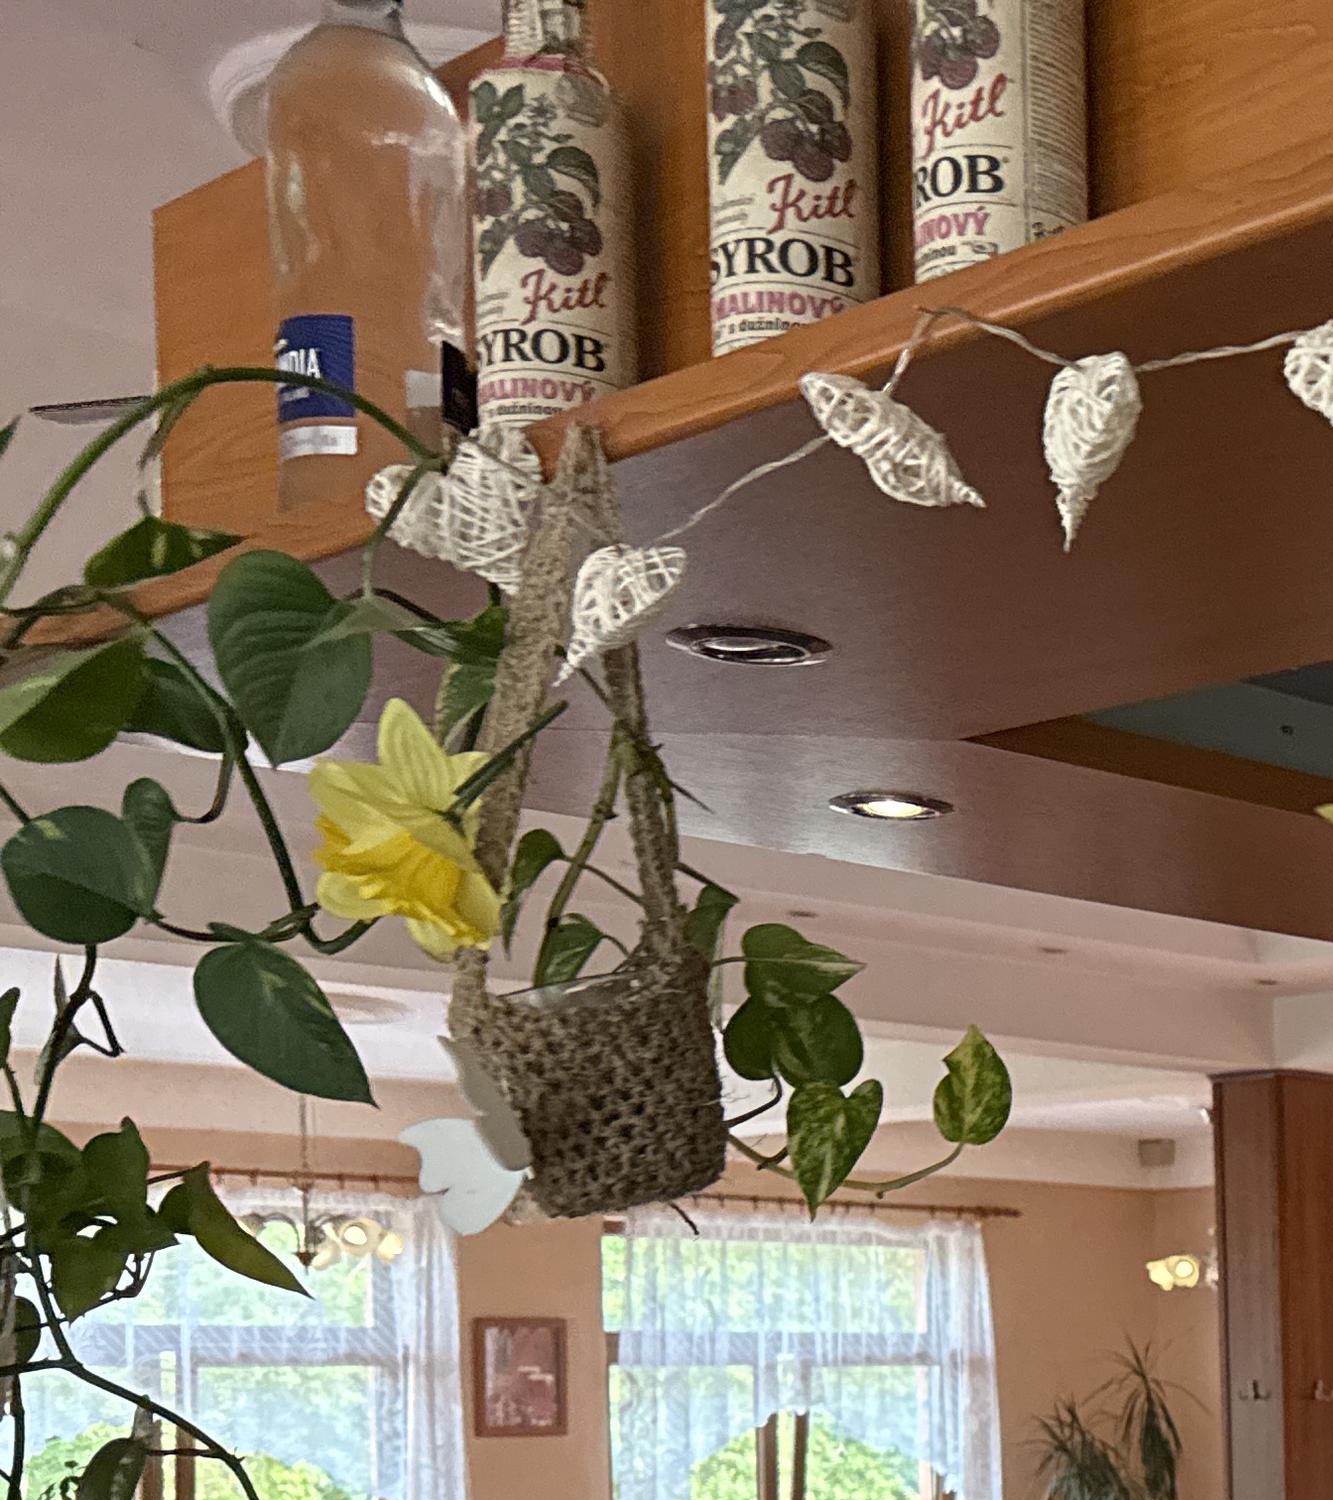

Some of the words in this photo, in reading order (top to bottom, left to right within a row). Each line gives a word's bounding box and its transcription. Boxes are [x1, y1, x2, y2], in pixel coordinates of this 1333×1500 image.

[922, 73, 1009, 162] Kitl
[766, 173, 858, 235] Kitl
[914, 154, 1005, 208] ROB
[520, 268, 612, 326] Kitl
[478, 328, 607, 373] YROB
